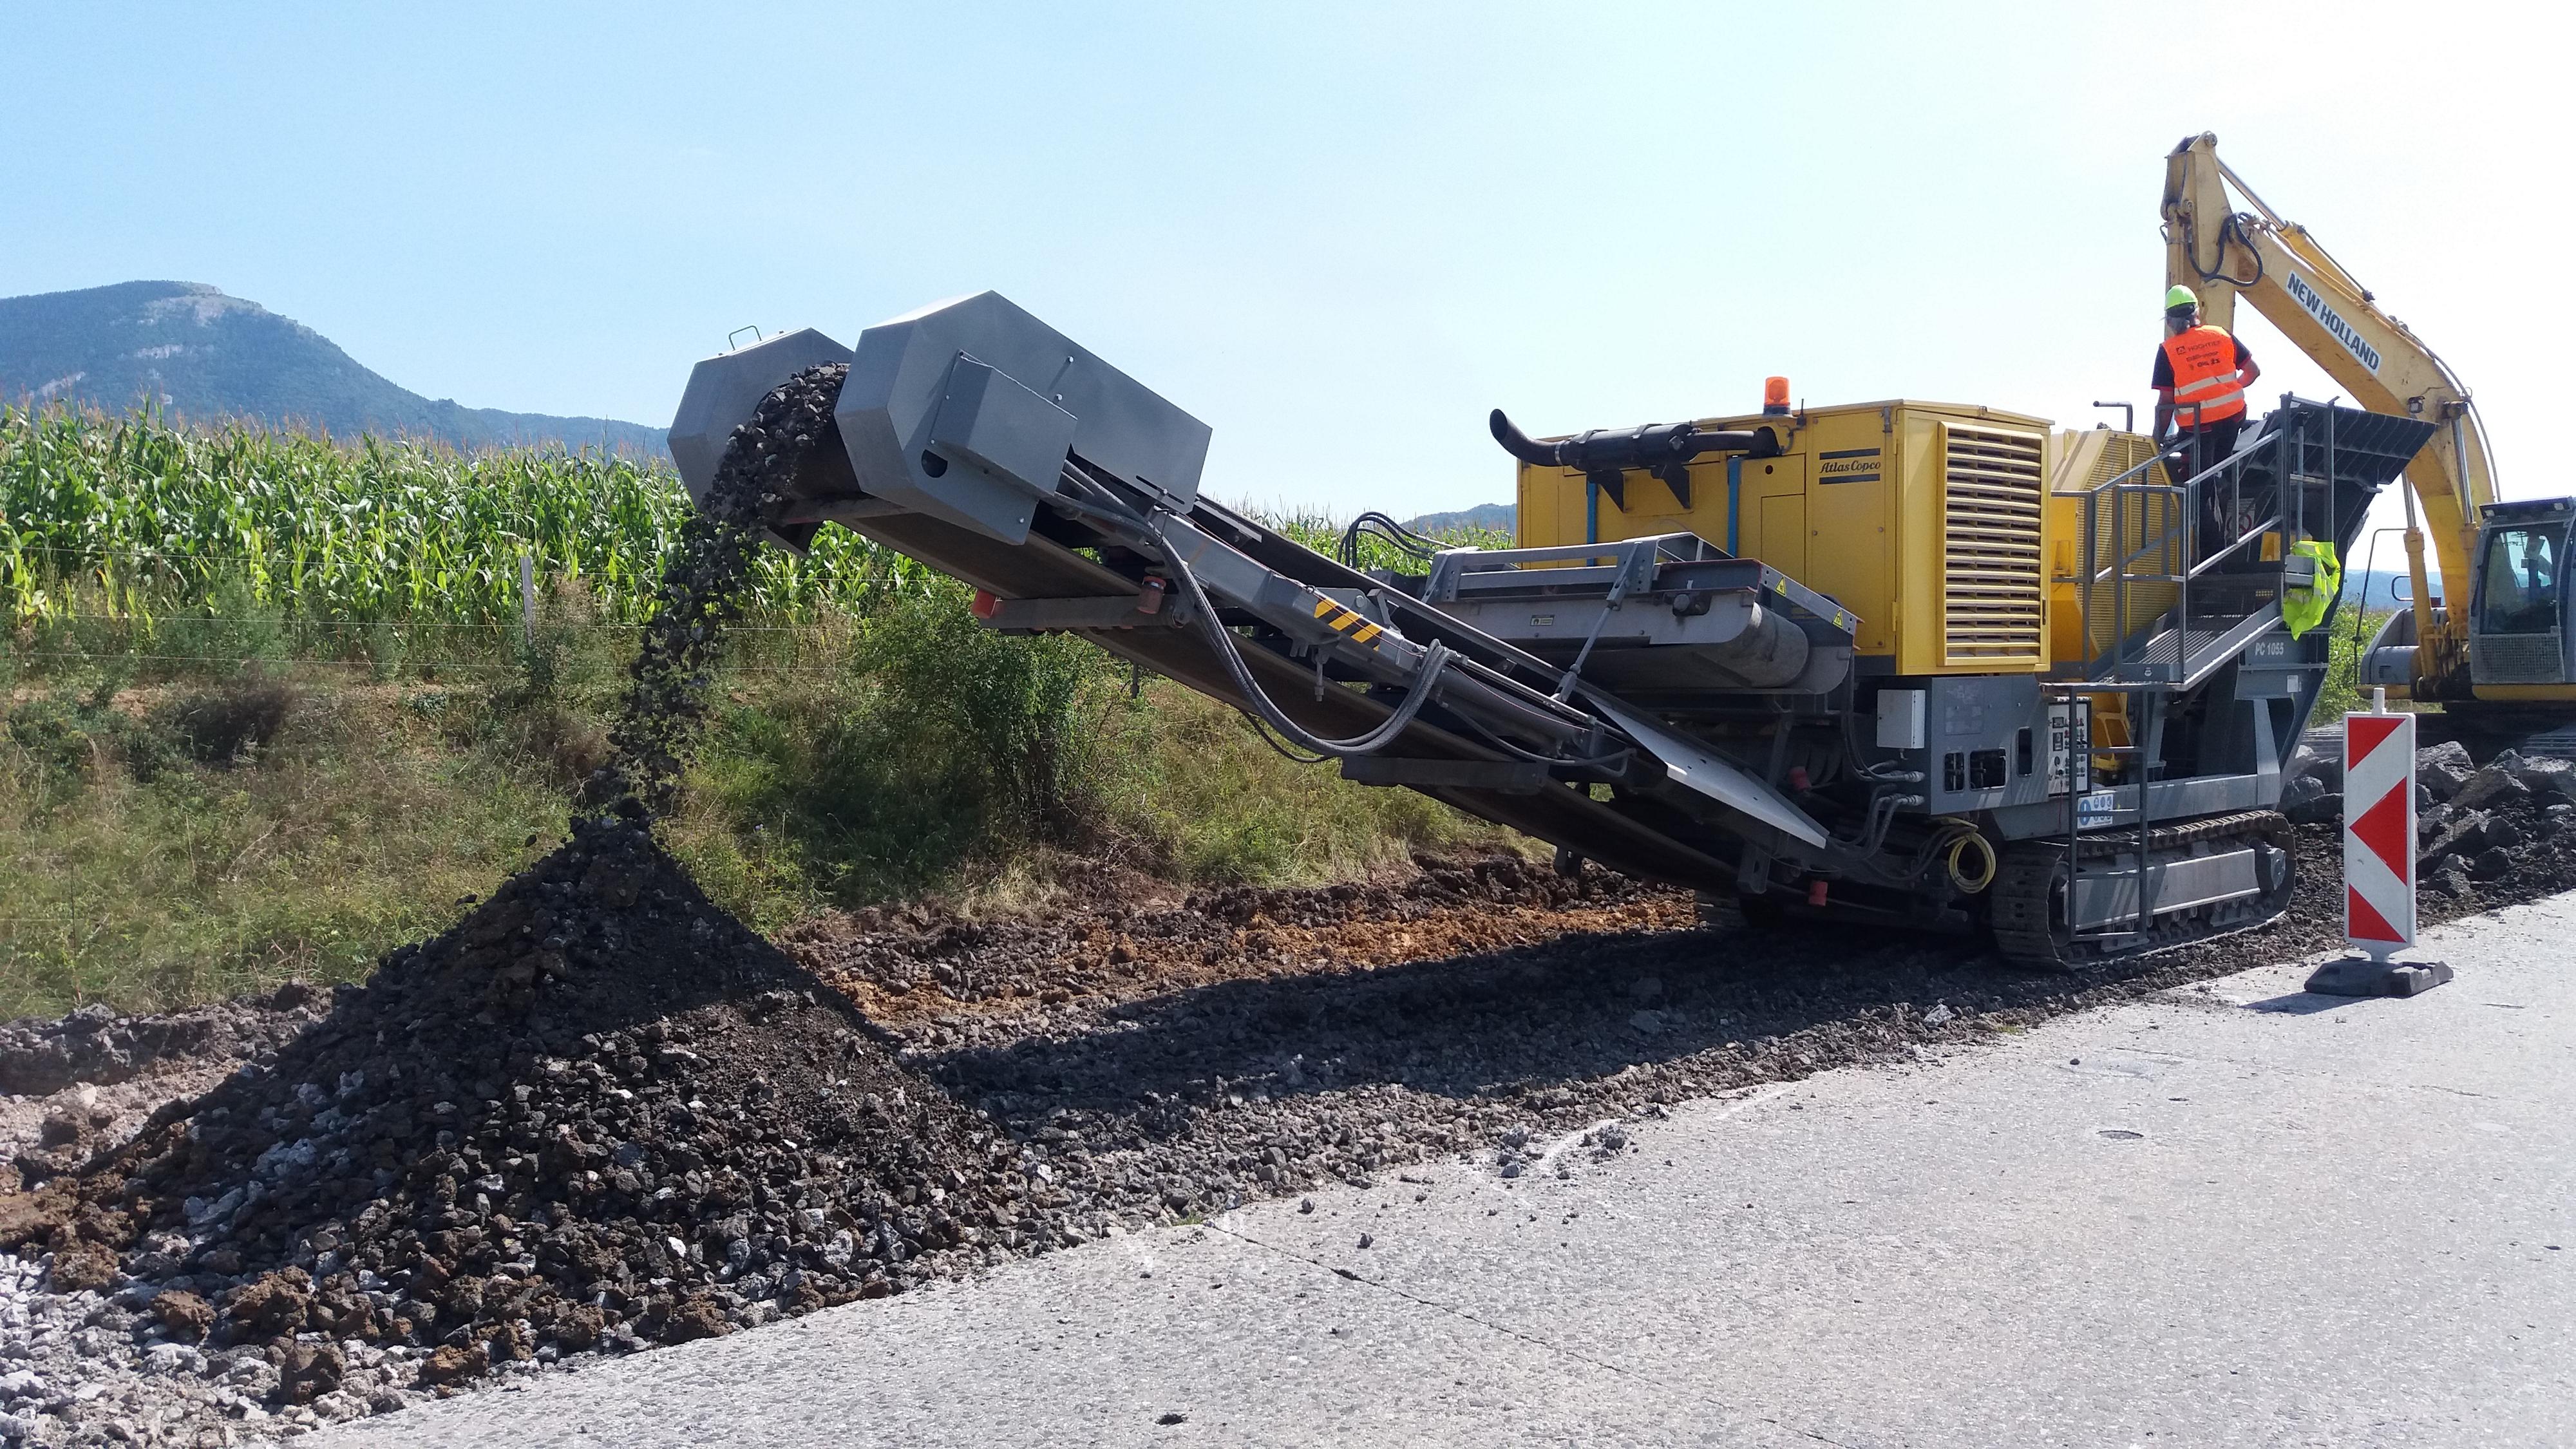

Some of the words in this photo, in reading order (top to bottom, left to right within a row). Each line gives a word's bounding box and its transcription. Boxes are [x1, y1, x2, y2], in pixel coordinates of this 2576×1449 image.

[2287, 272, 2320, 312] NEW
[2320, 303, 2380, 370] HOLLAND
[1819, 462, 1850, 473] Atlas
[1851, 460, 1881, 472] Copco
[2255, 642, 2266, 656] PC
[2267, 641, 2284, 655] 1055
